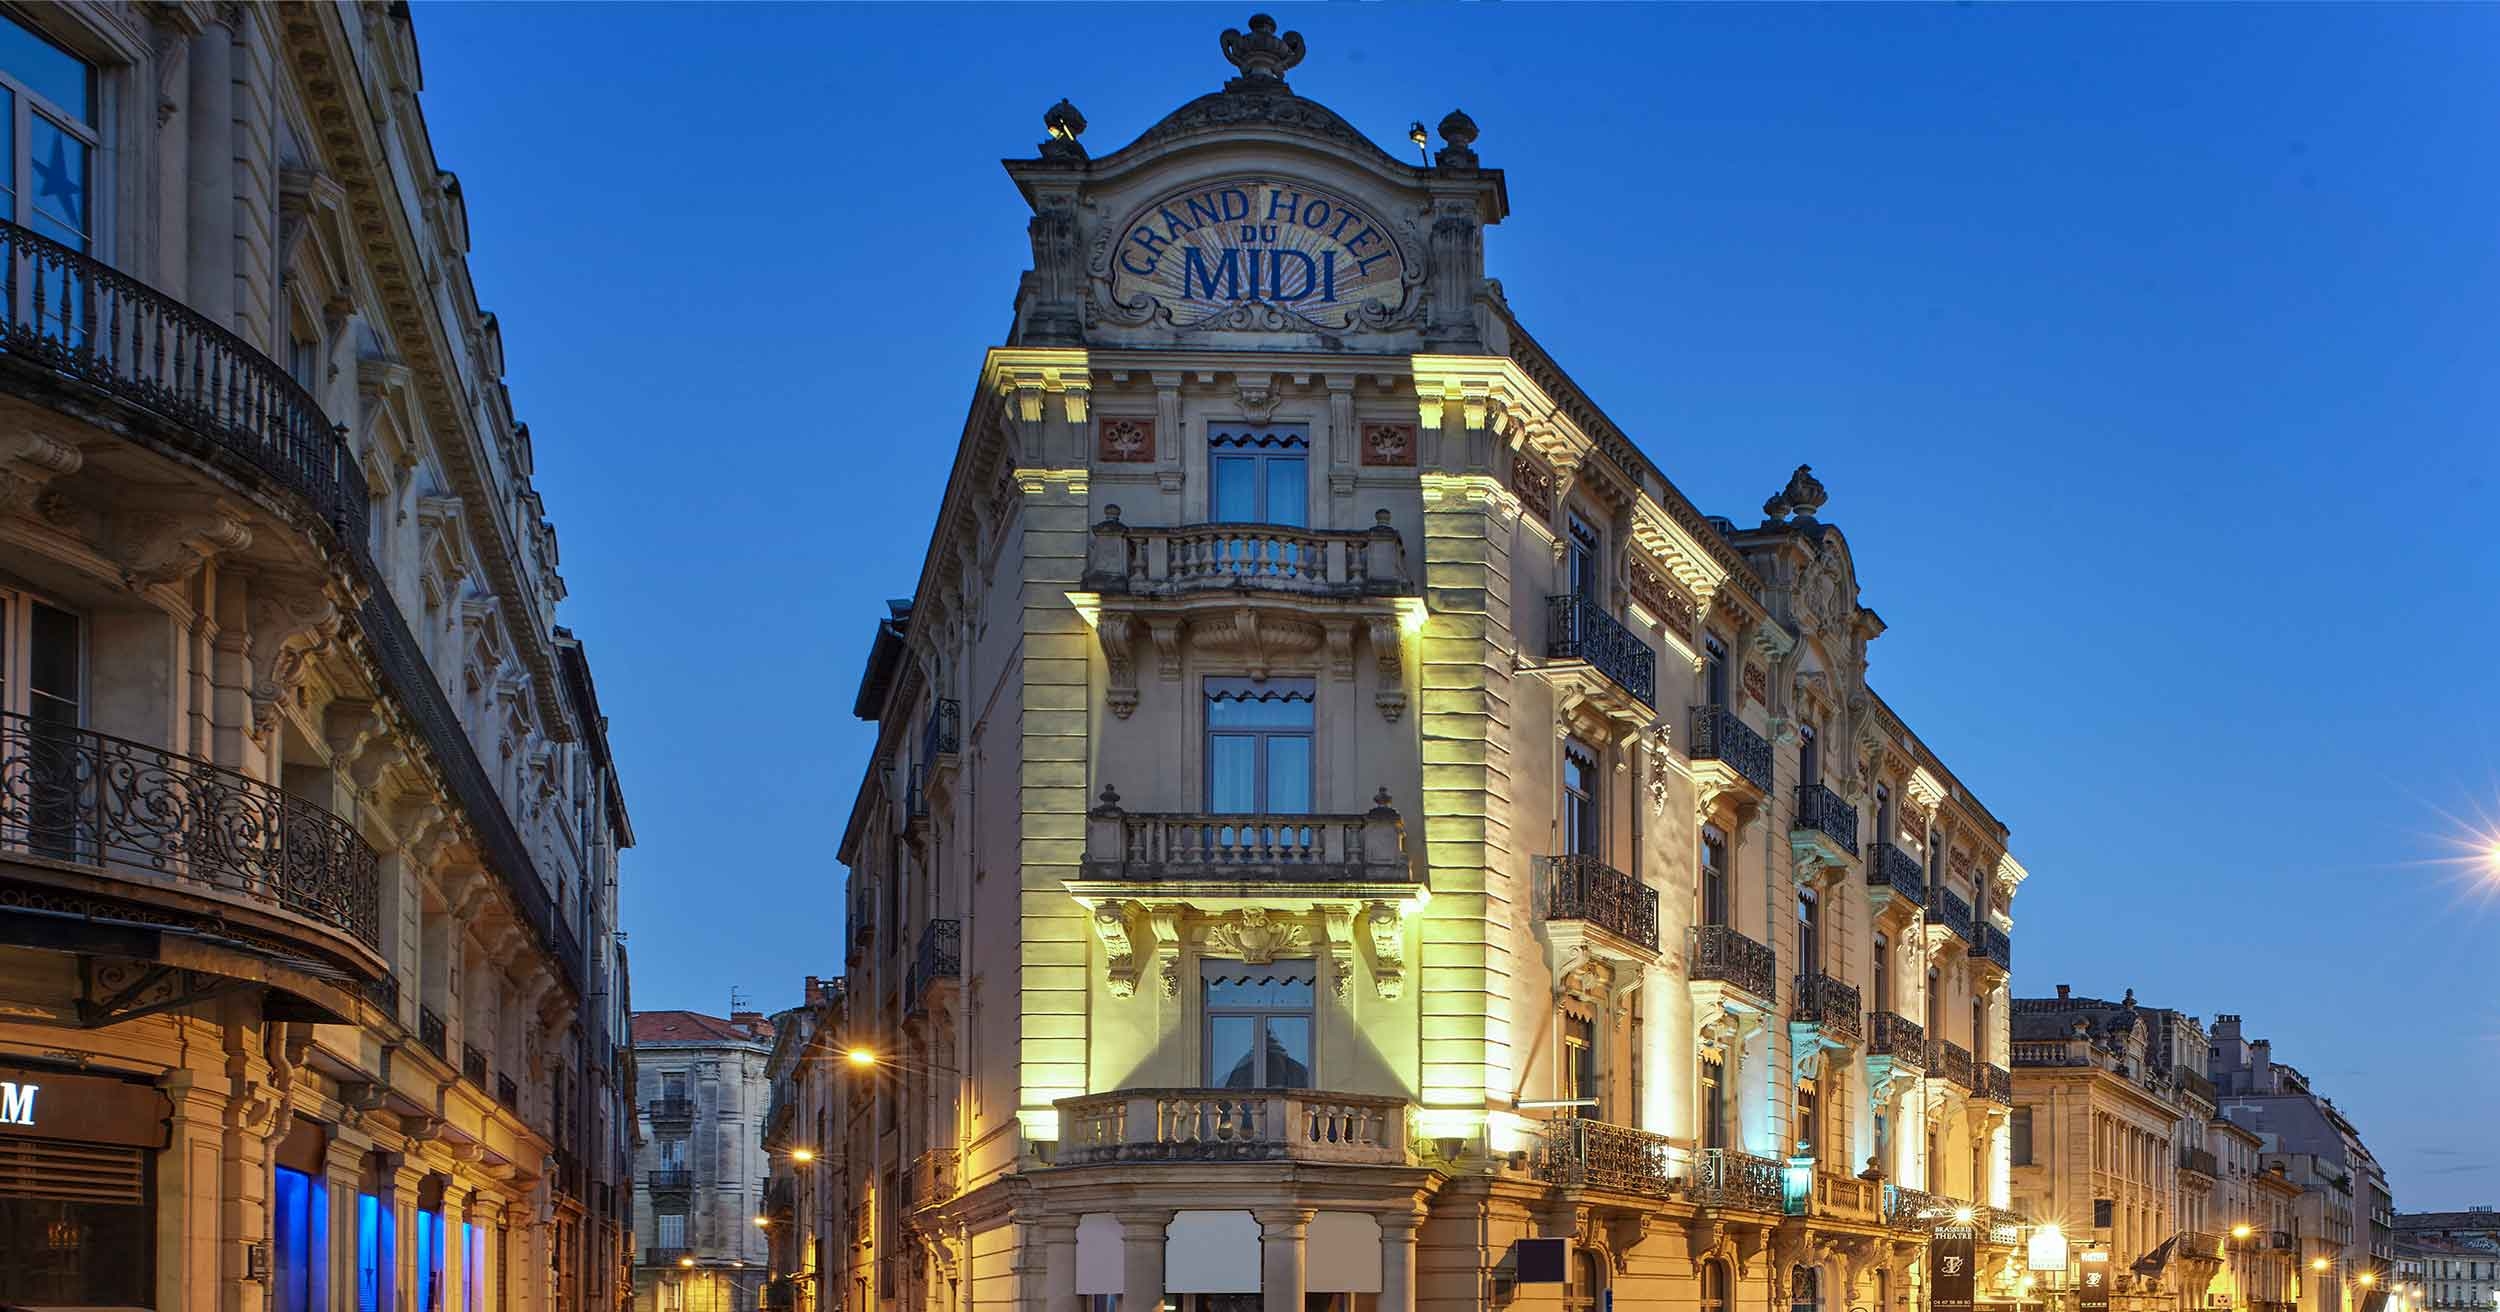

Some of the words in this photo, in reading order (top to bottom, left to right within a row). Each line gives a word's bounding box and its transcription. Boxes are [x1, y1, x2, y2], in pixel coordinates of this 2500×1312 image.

[1119, 188, 1250, 277] GRAND
[1267, 188, 1393, 278] HOTEL
[1239, 224, 1278, 244] DU
[1182, 245, 1339, 303] MIDI
[1935, 1232, 1972, 1240] THEATRE
